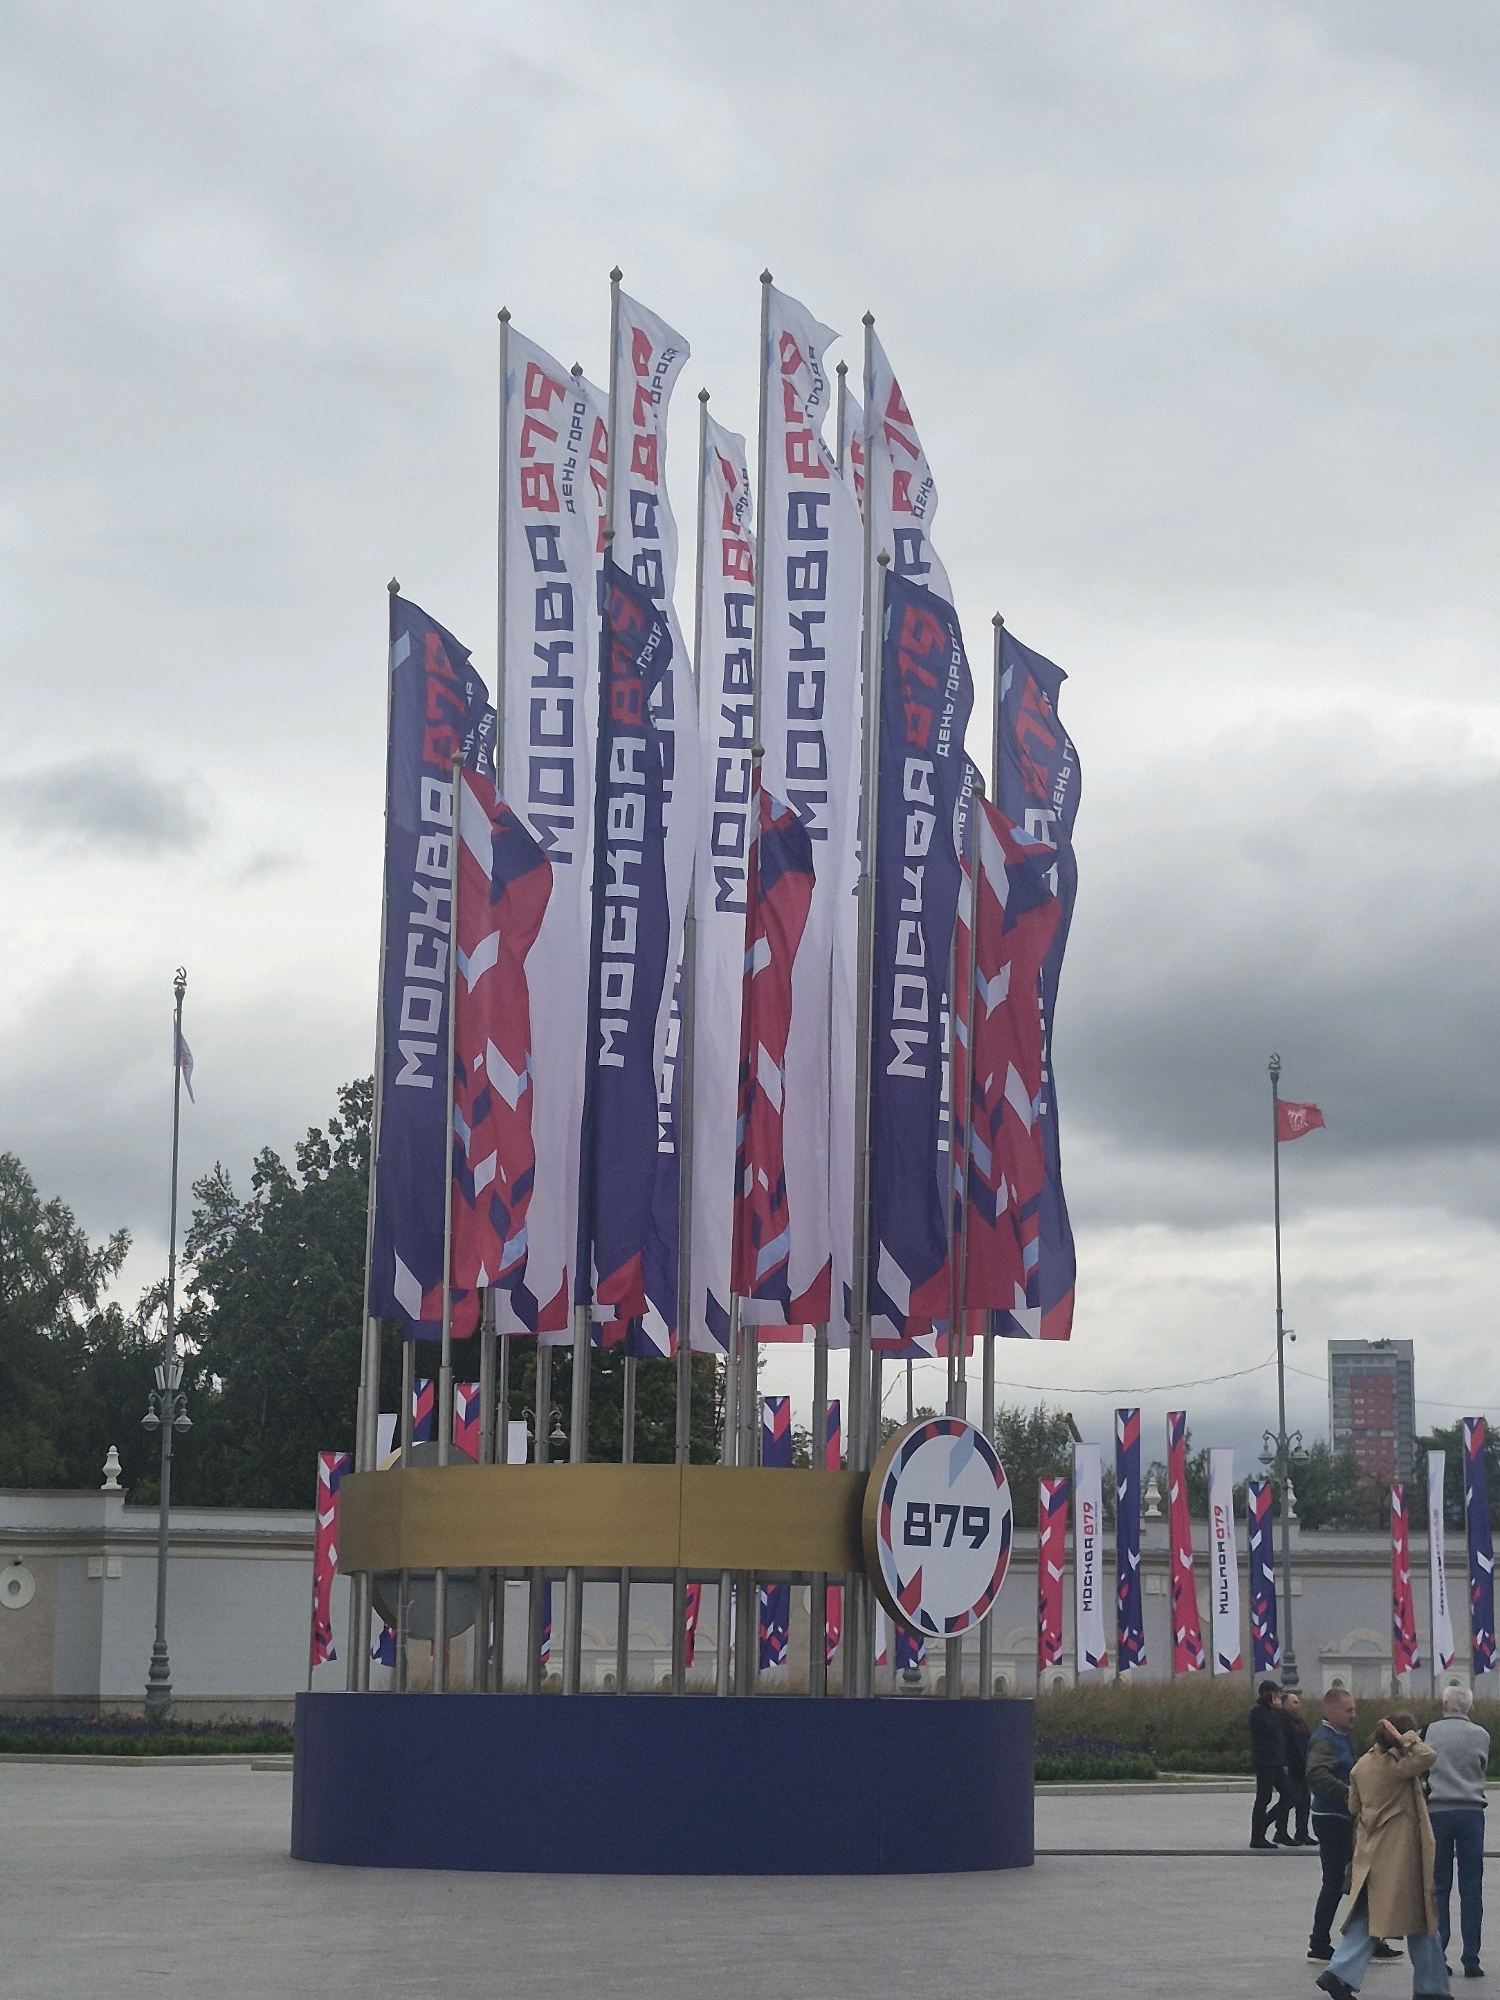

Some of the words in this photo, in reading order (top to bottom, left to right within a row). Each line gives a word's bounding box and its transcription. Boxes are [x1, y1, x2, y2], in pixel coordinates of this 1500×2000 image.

[567, 401, 587, 453] ГОРО
[936, 703, 955, 757] ДЕНЬ
[599, 737, 647, 1068] МОСКВА
[903, 1501, 991, 1549] 879
[1082, 1502, 1094, 1536] 879
